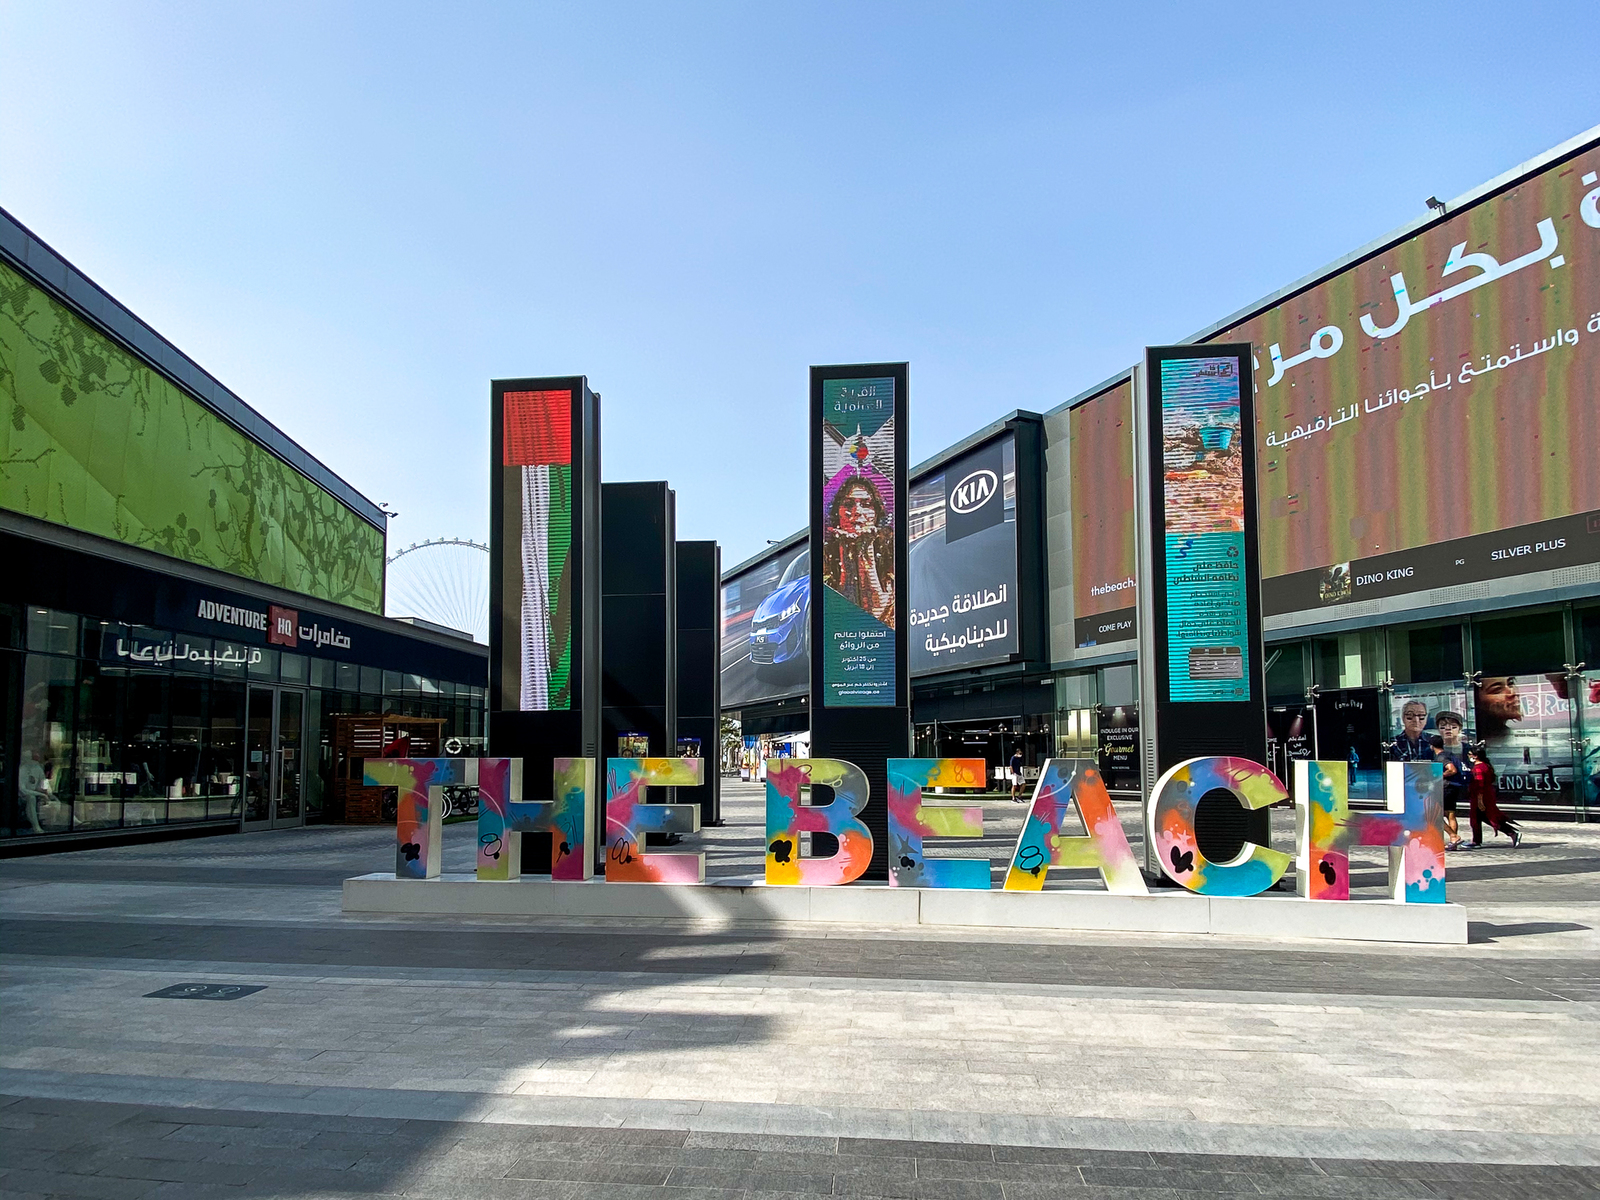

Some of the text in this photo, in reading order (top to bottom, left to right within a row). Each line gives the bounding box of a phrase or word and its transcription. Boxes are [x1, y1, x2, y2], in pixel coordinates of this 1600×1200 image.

[1360, 217, 1565, 339] بكل
[1265, 328, 1580, 447] واستمتع بأجوائنا الترفيهية
[957, 476, 990, 509] KIA
[1491, 538, 1567, 561] SILVER PLUS
[1356, 567, 1414, 586] DINO KING
[198, 599, 292, 637] ADVENTURE HQ
[909, 583, 1007, 627] انطلاقة جديدة
[298, 623, 351, 649] مغامرات
[924, 618, 1008, 656] للديناميكية
[1098, 620, 1132, 633] COME PLAY
[1103, 743, 1135, 757] Gourmet
[1498, 774, 1562, 791] ENDLESS
[364, 756, 1447, 904] THE BEACH
